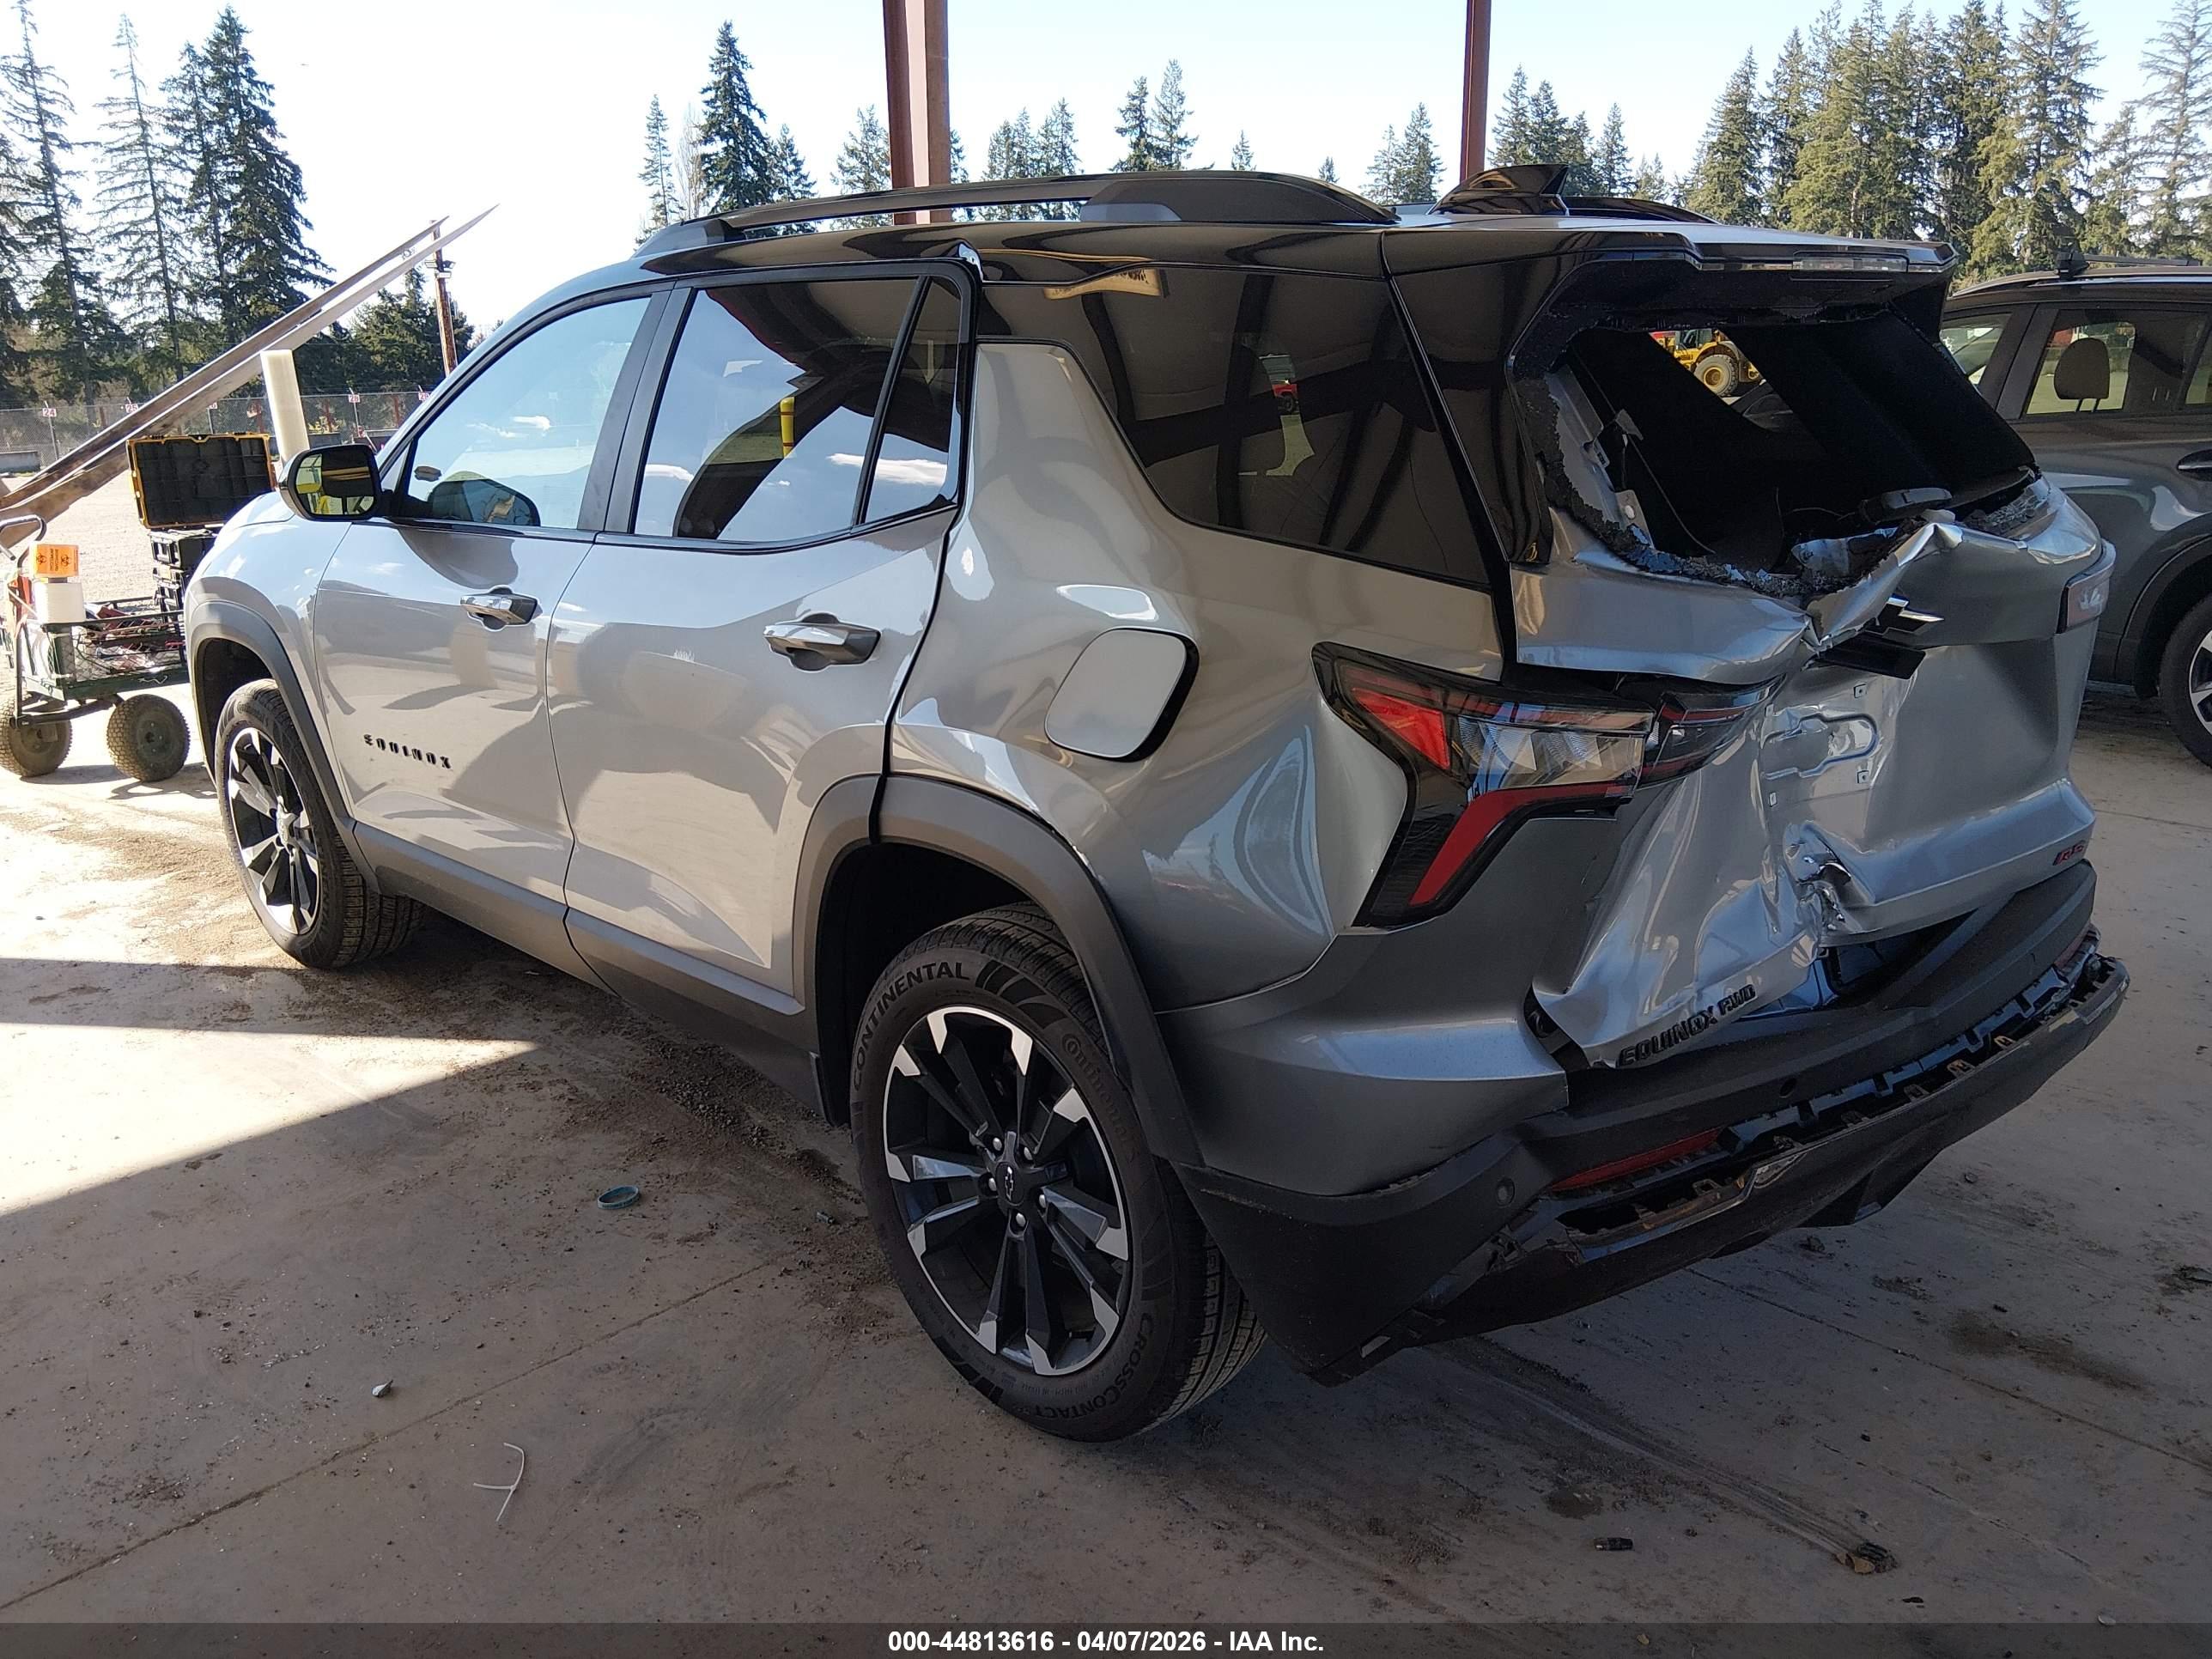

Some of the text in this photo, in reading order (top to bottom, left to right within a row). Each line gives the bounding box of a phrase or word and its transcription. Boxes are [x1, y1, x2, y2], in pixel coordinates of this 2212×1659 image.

[363, 734, 451, 769] EQUINOX
[854, 961, 969, 1091] CONTINENTAL
[1618, 1006, 1718, 1067] EQUINOX
